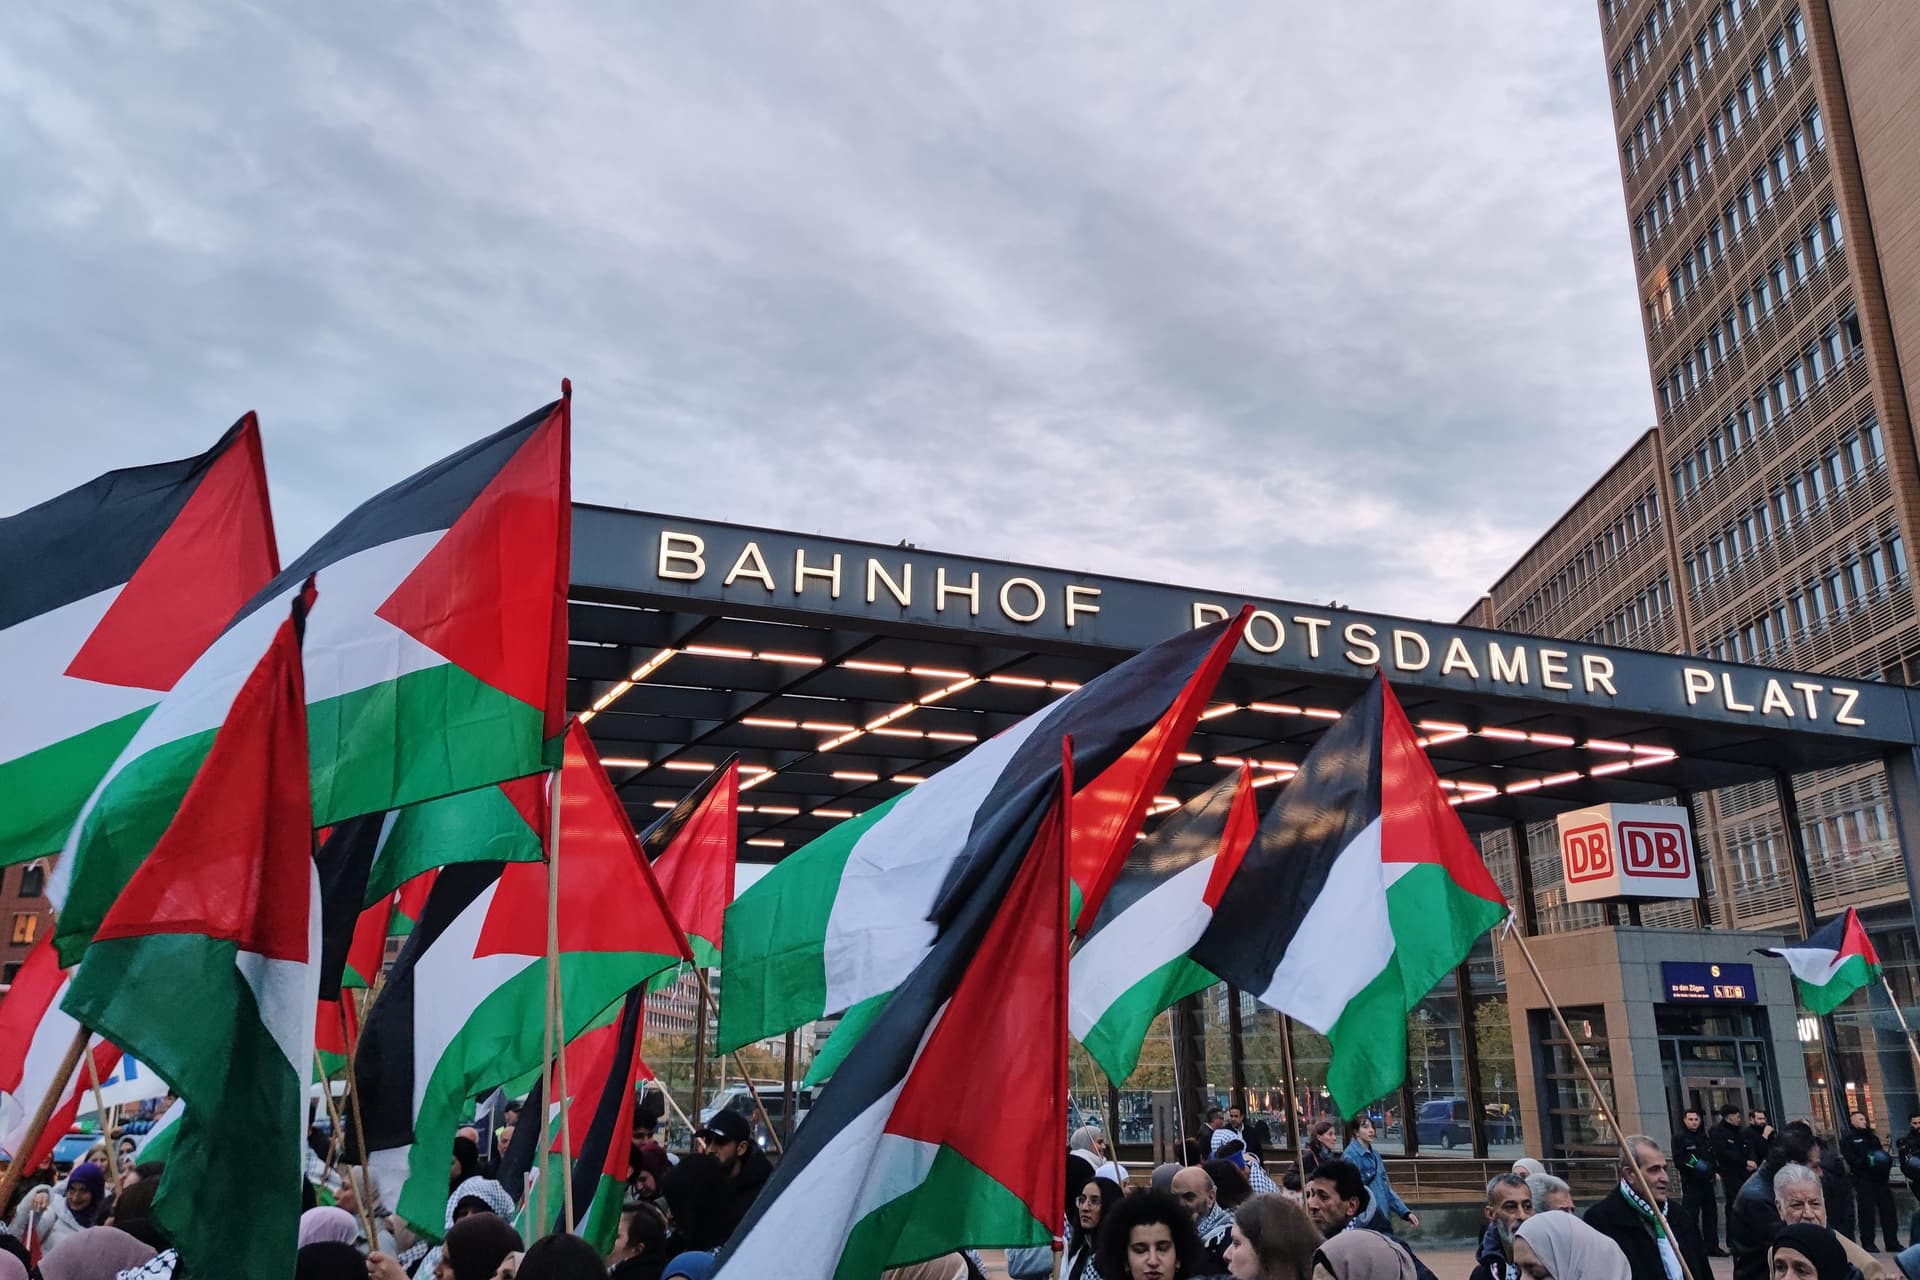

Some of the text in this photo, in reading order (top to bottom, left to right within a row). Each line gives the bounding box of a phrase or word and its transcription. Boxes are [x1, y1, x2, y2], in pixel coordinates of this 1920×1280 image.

[658, 530, 1102, 628] BAHNHOF
[1683, 667, 1866, 726] PLATZ
[1569, 833, 1607, 873] DB
[1627, 830, 1681, 869] DB
